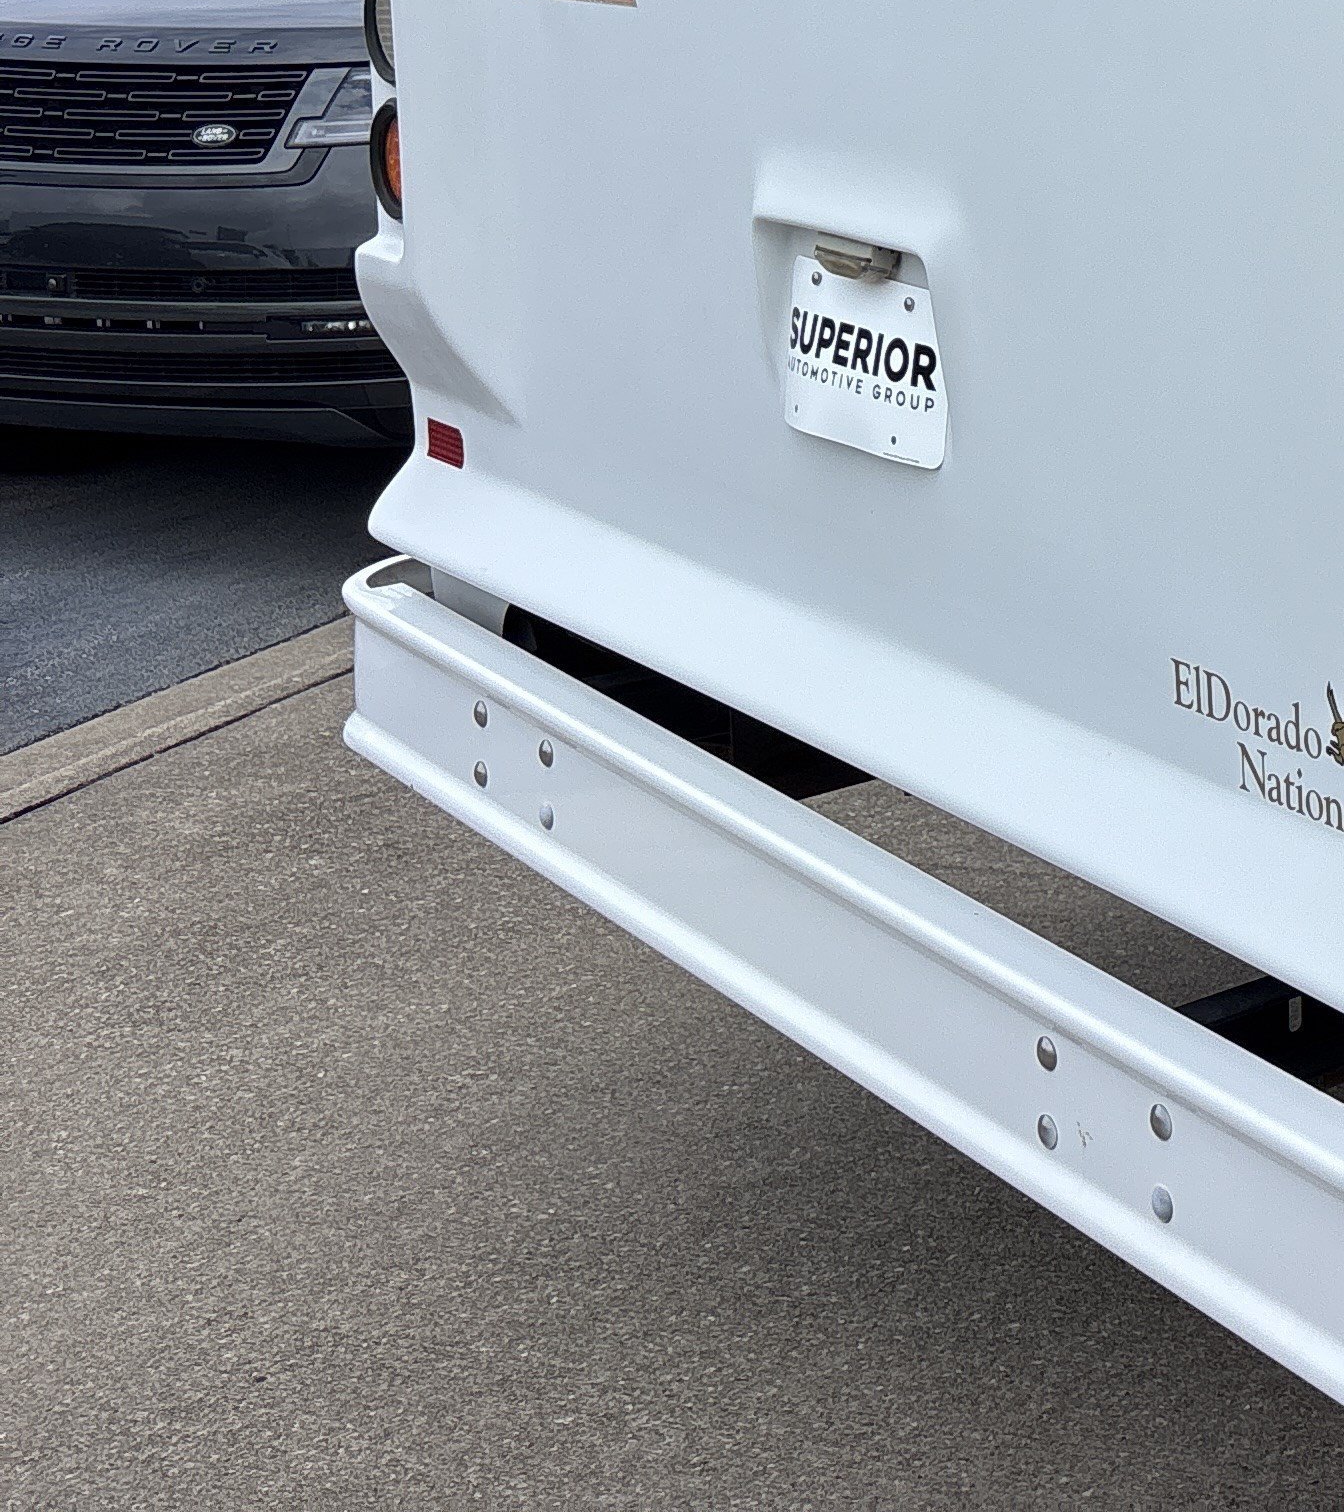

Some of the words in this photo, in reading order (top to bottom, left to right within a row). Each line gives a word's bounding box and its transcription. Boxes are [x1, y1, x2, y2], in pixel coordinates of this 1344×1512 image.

[0, 32, 67, 50] GE
[96, 38, 278, 54] ROVER
[790, 306, 937, 392] SUPERIOR
[872, 383, 935, 413] GROUP
[1170, 657, 1323, 759] ElDorado
